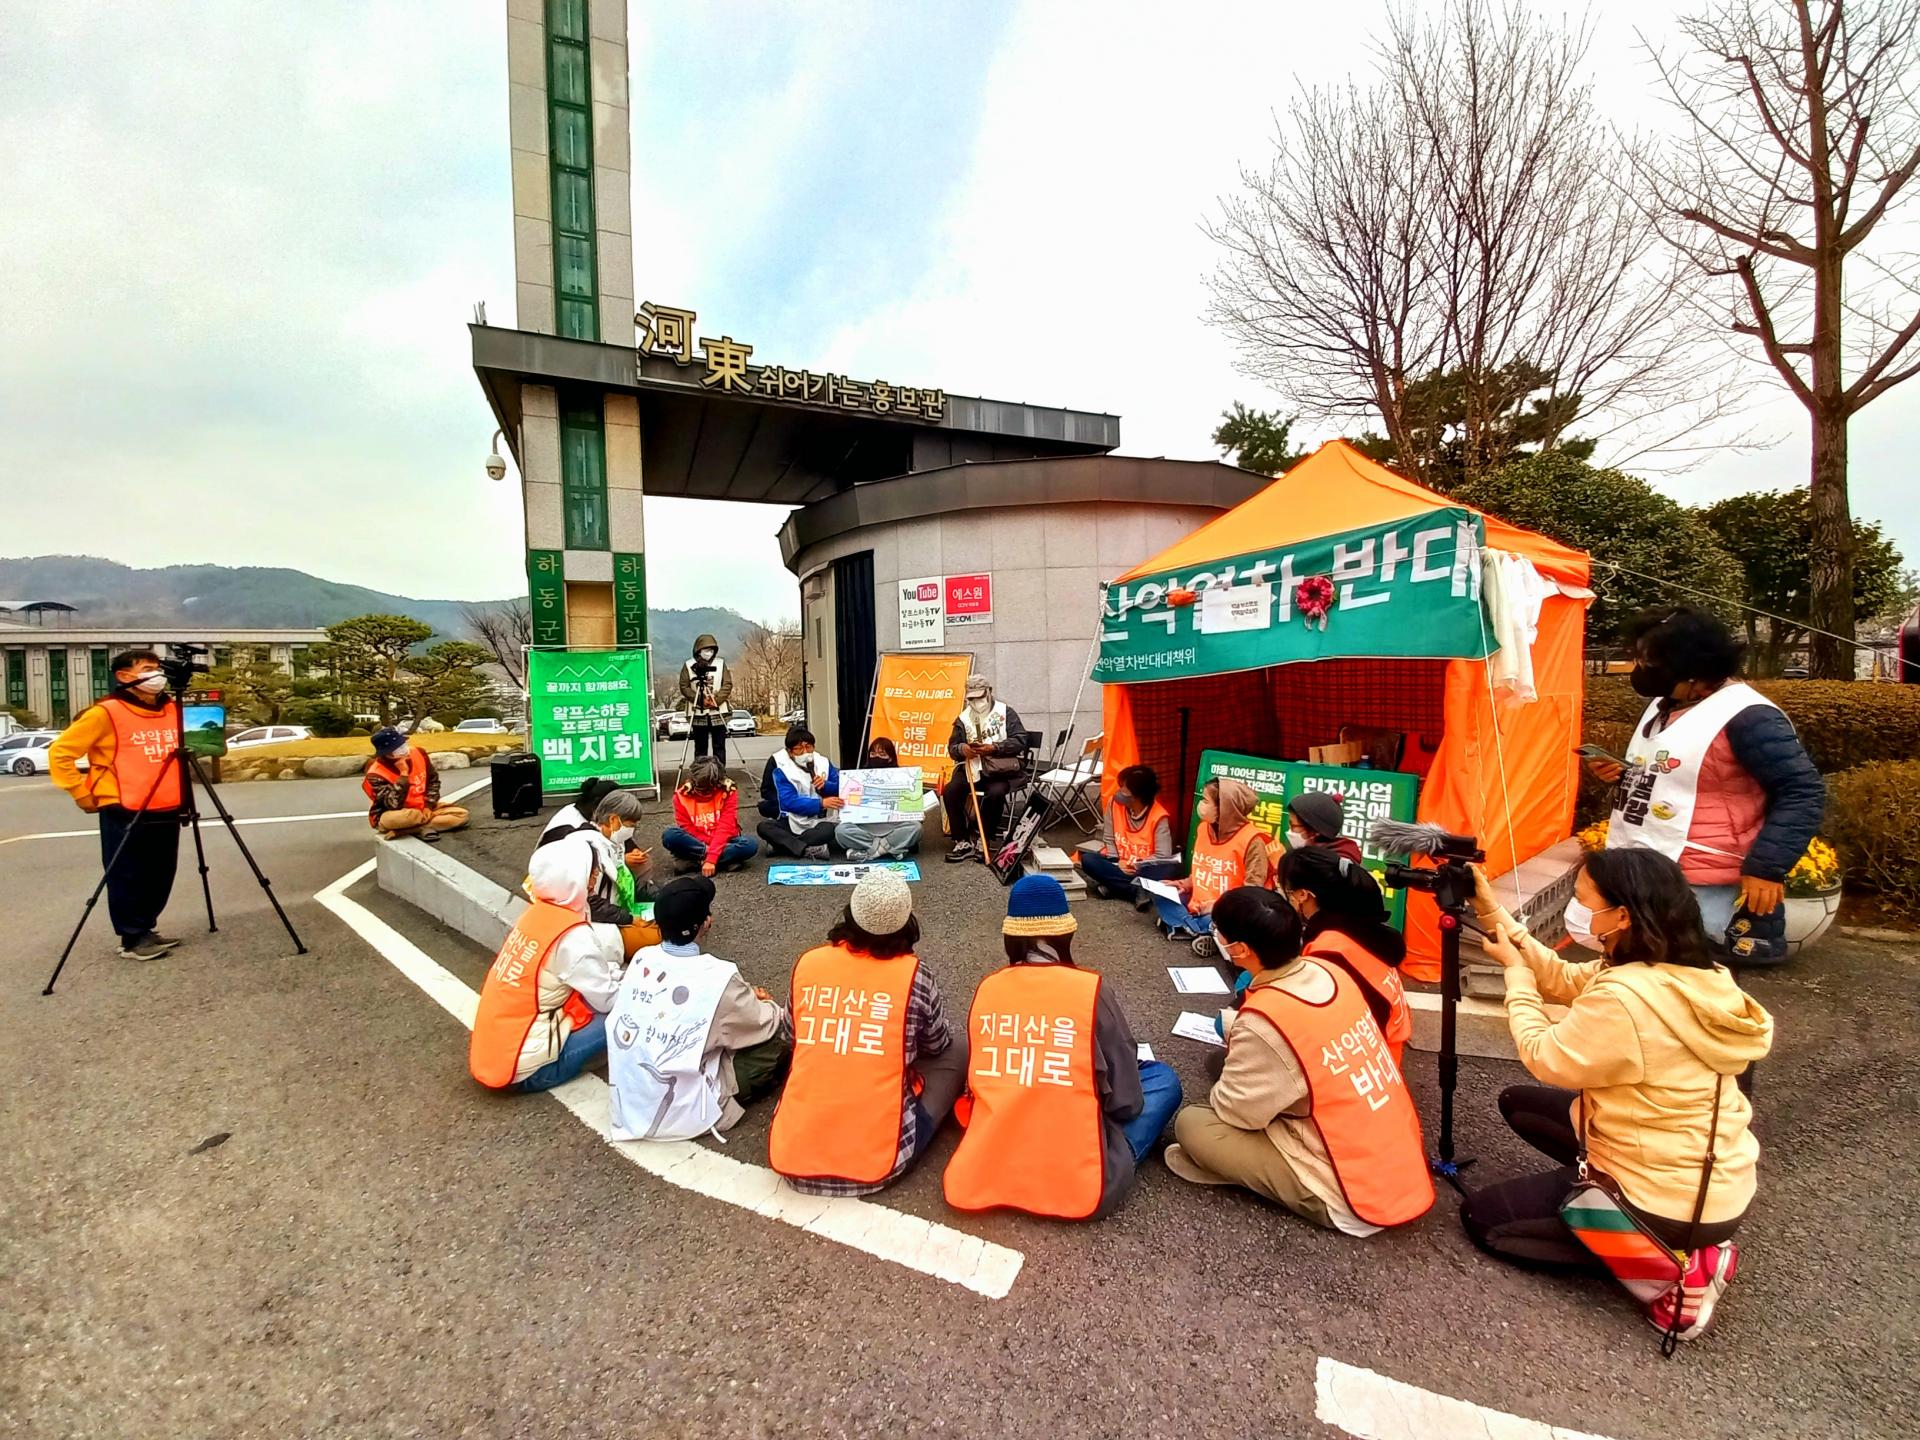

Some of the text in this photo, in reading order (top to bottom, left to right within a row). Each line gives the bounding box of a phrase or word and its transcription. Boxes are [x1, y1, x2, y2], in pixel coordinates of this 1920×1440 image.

[634, 301, 947, 420] 河東 쉬어가는 홍보관
[1333, 520, 1482, 611] 반대
[536, 554, 560, 641] 하동군
[902, 583, 938, 601] YouTube
[952, 586, 983, 600] 에스원
[946, 615, 972, 623] SECOM
[546, 680, 632, 693] 끝까지 함께해요.
[883, 687, 912, 698] 알프스
[552, 703, 630, 720] 알프스하동
[898, 711, 935, 725] 우리의
[561, 718, 623, 734] 프로젝트
[903, 727, 928, 741] 하동
[543, 733, 643, 765] 백지화
[1230, 766, 1256, 780] 100년
[798, 984, 894, 1021] 지리산을
[796, 1016, 885, 1056] 그대로
[978, 1012, 1078, 1049] 지리산을
[975, 1046, 1074, 1087] 그대로
[1349, 1041, 1402, 1112] 반대
